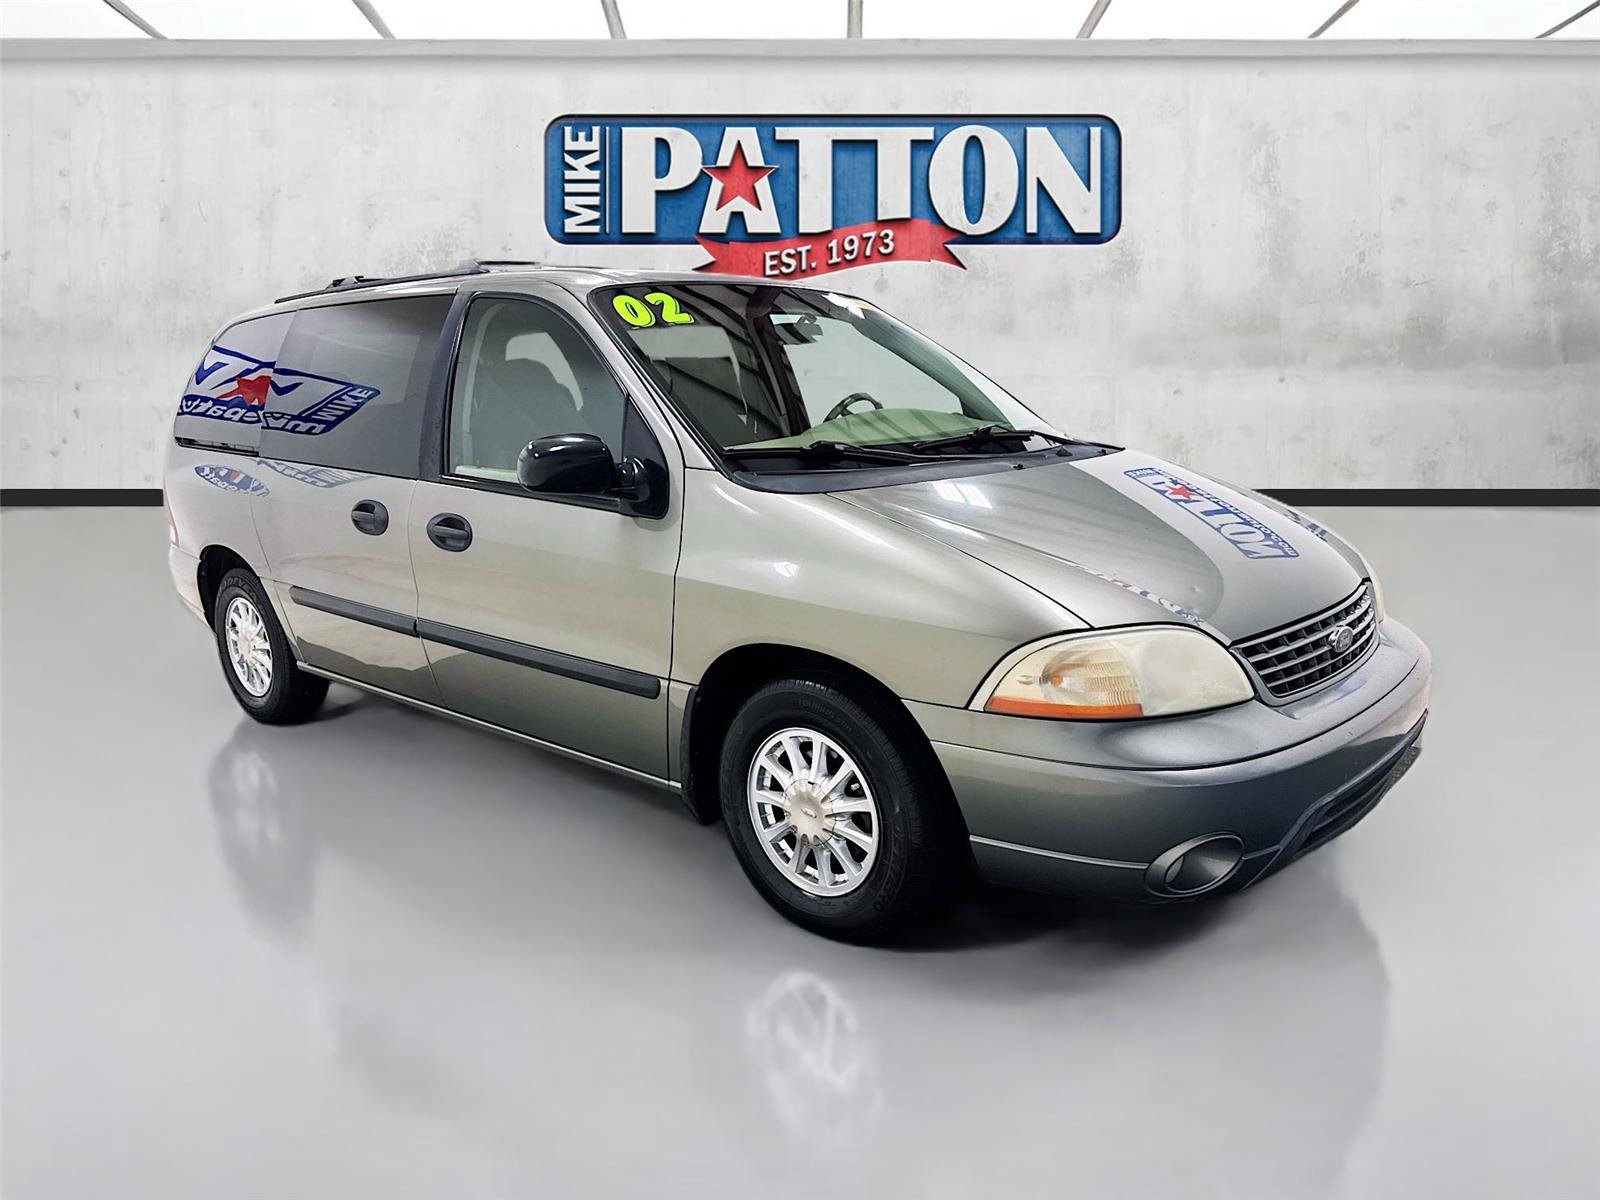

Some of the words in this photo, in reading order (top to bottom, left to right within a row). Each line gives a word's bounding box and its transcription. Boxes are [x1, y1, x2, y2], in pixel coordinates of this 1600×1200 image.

[563, 125, 600, 234] MIKE
[621, 124, 1102, 236] PATTON
[764, 245, 817, 277] EST.
[827, 228, 895, 264] 1973
[612, 292, 695, 327] 02
